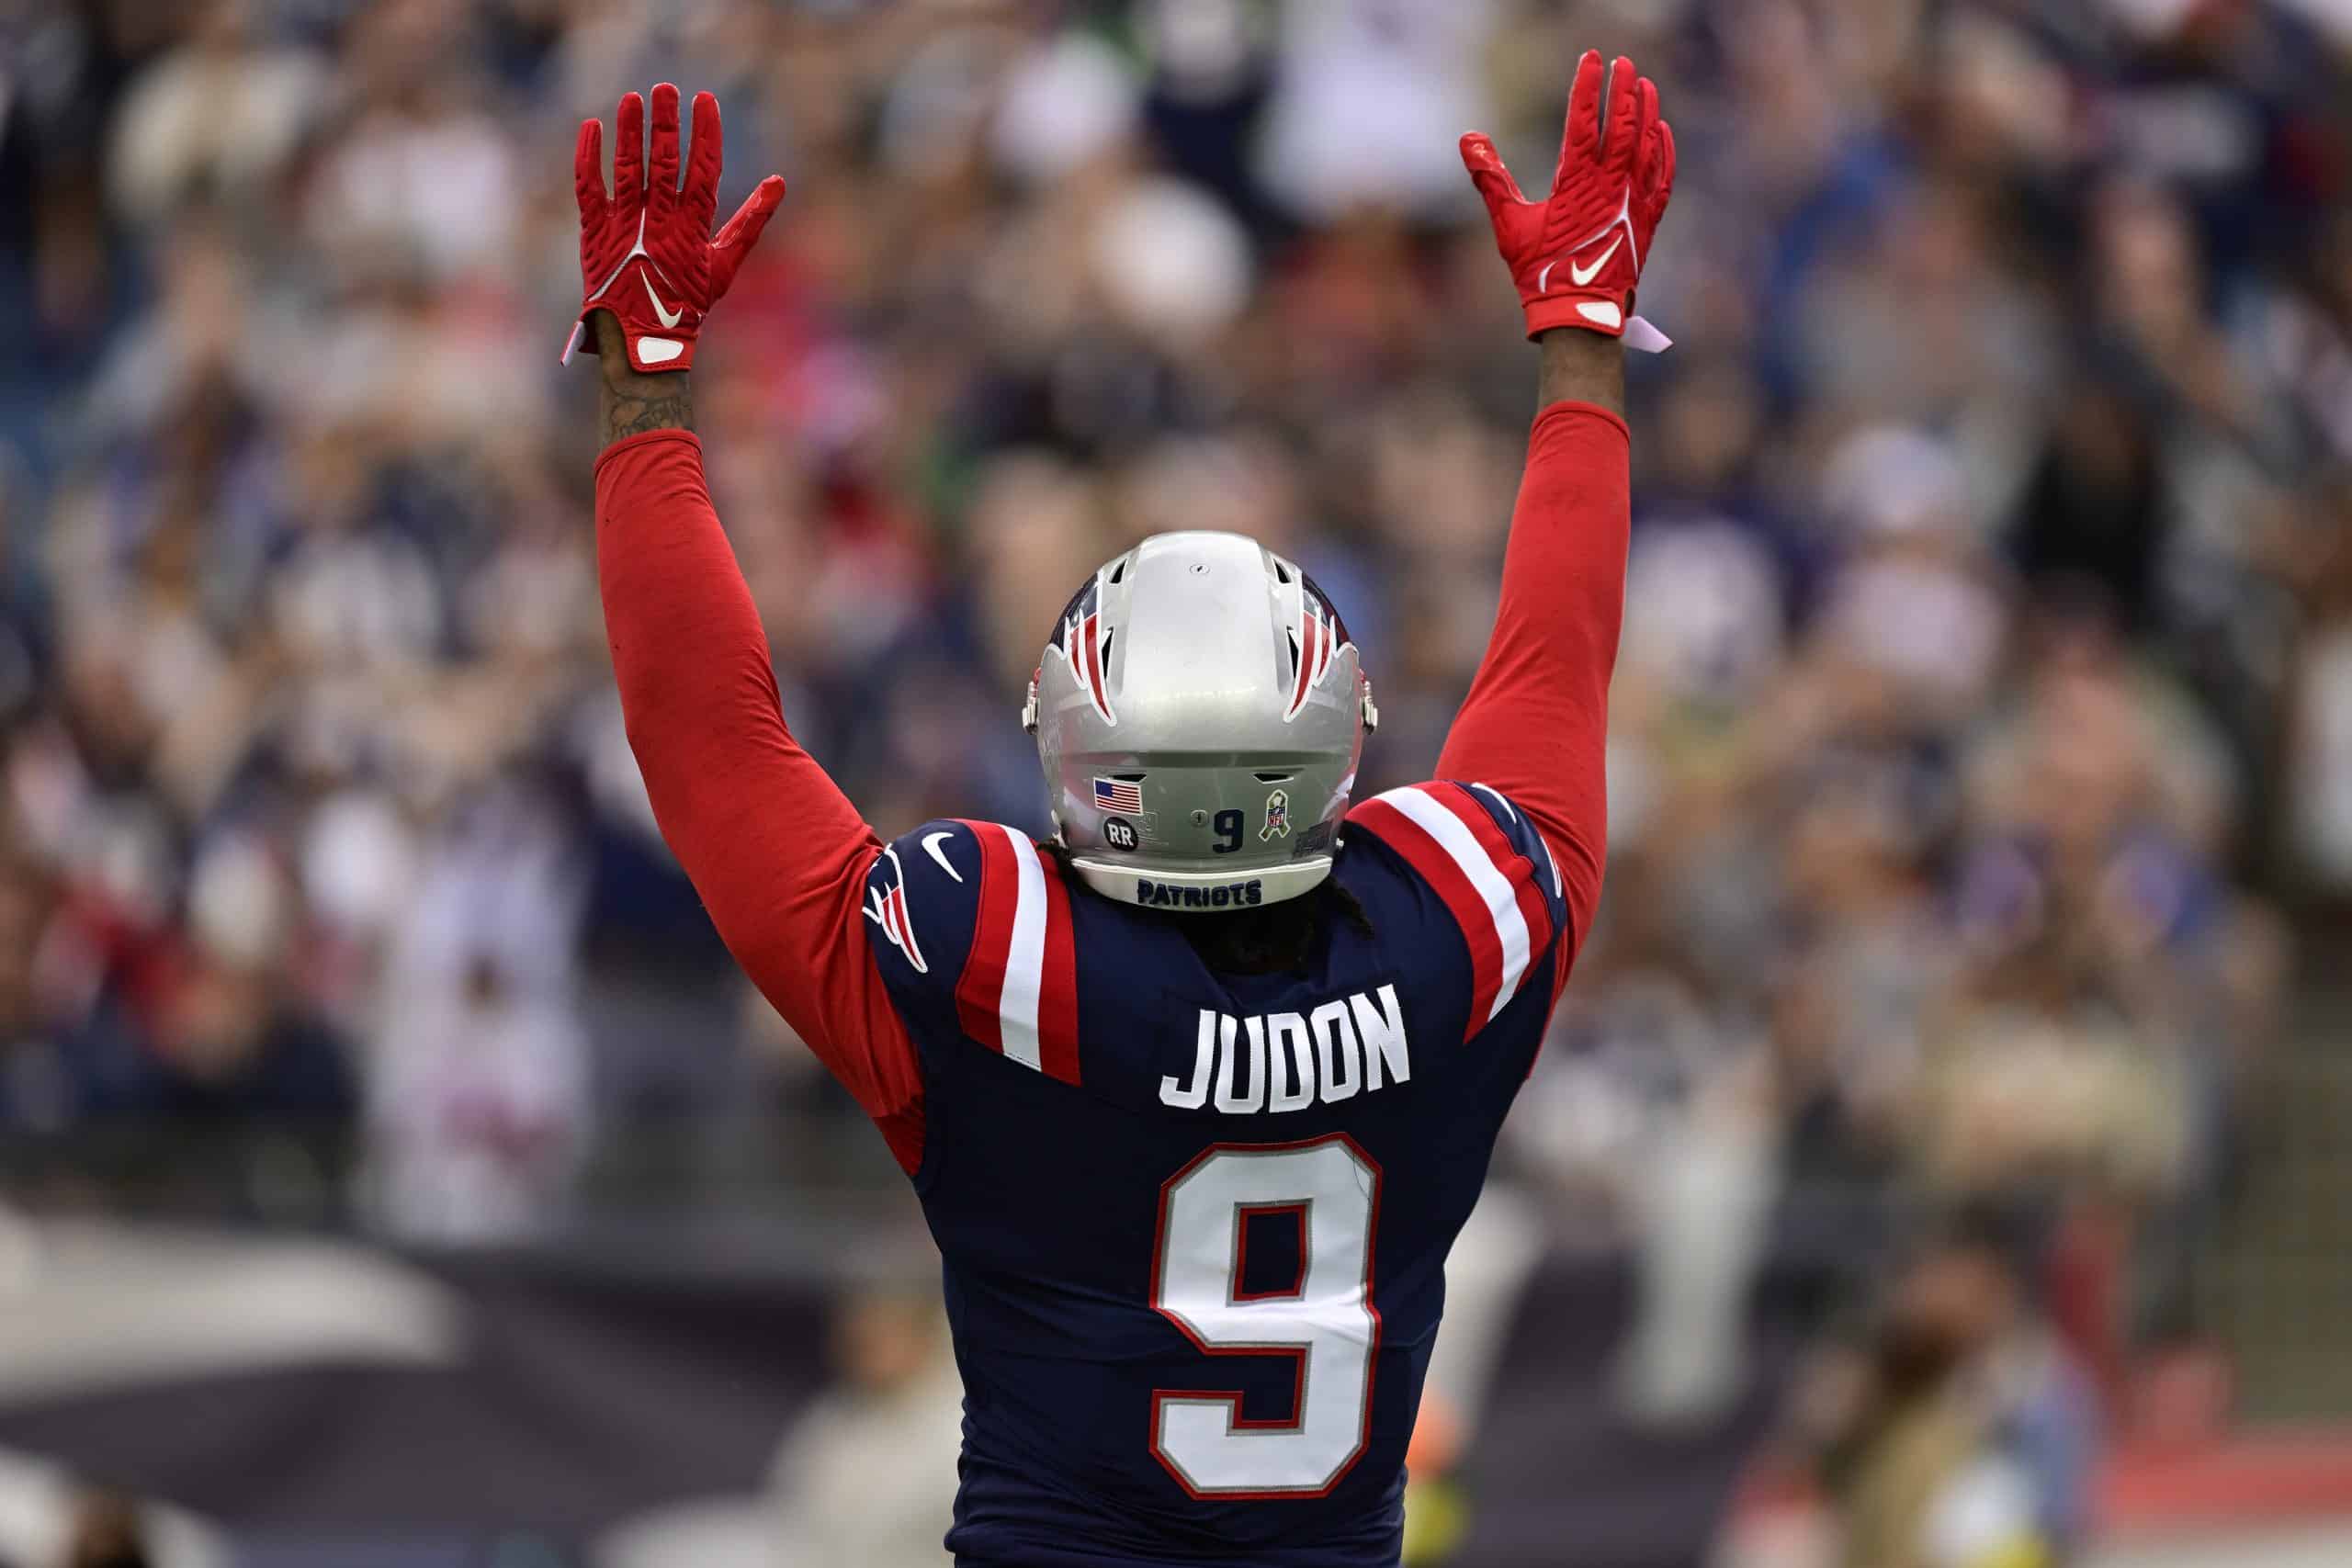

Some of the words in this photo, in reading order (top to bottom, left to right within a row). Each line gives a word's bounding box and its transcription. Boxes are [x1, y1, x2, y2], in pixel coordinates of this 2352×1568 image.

[1107, 823, 1134, 846] RR
[1213, 809, 1245, 854] 9
[1268, 814, 1284, 827] NFL
[1137, 878, 1261, 907] PATRIOTS
[1159, 983, 1410, 1114] JUDON
[1149, 1132, 1383, 1501] 9
